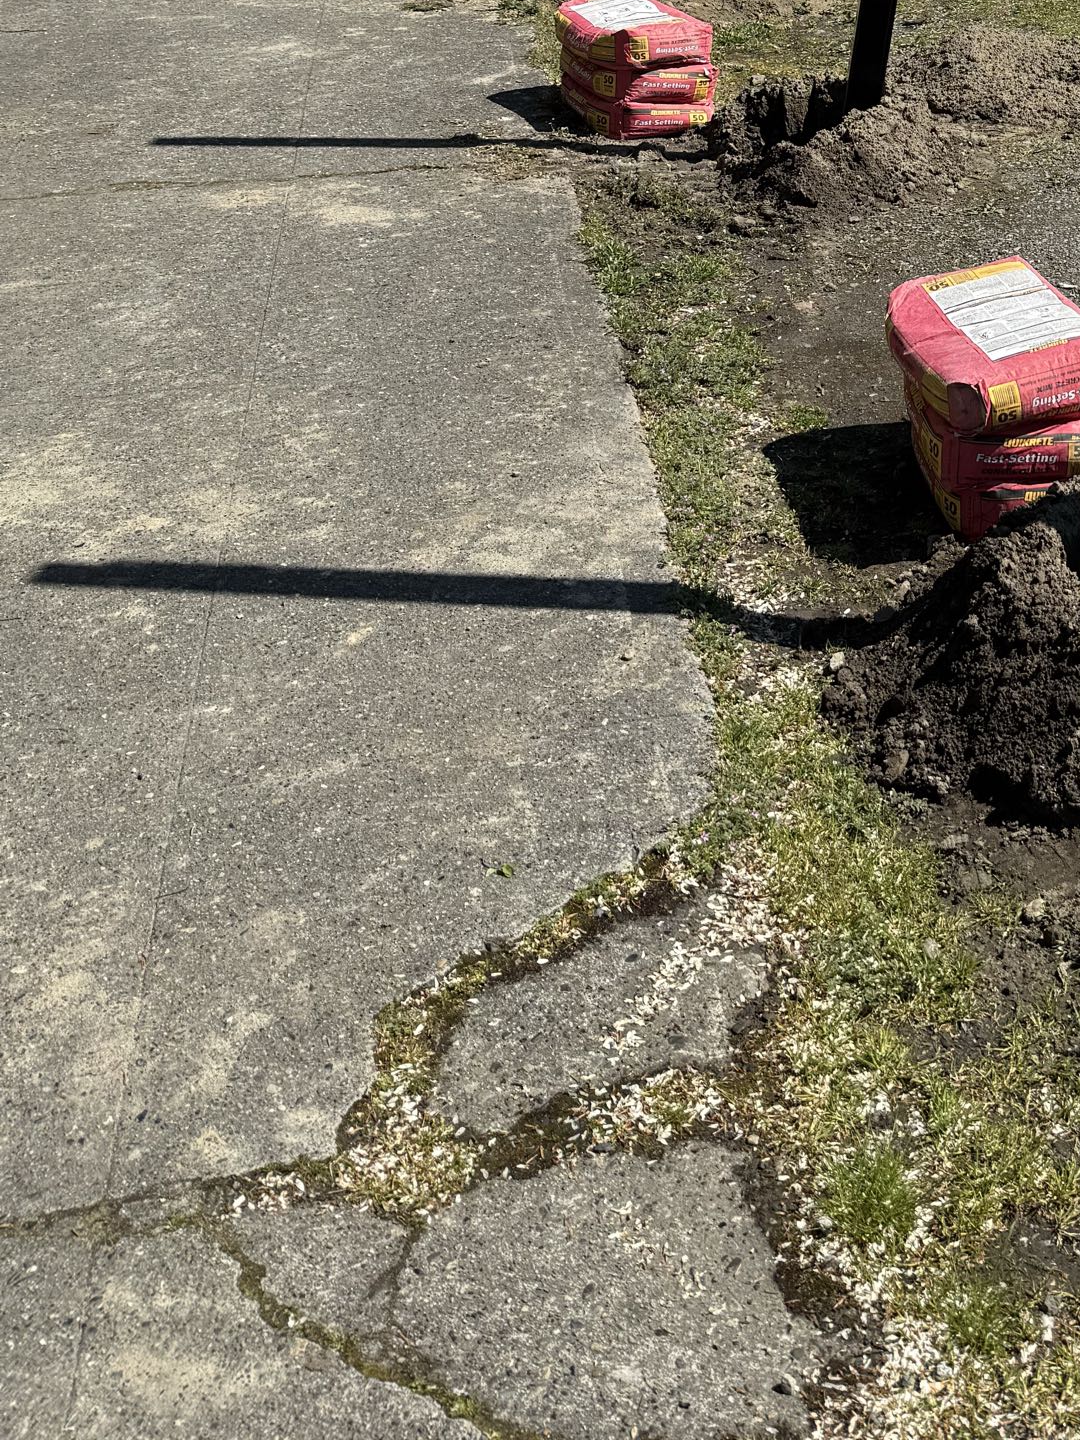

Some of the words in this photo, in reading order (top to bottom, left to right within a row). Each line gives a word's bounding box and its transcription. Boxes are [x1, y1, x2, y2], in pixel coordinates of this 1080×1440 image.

[602, 73, 614, 85] 50
[642, 81, 691, 90] Fast-Setting
[633, 119, 684, 127] Fast-Setting
[692, 114, 705, 122] 50
[997, 409, 1017, 423] 50
[1002, 436, 1055, 448] QUIKRETE
[975, 452, 1058, 465] Fast-Setting
